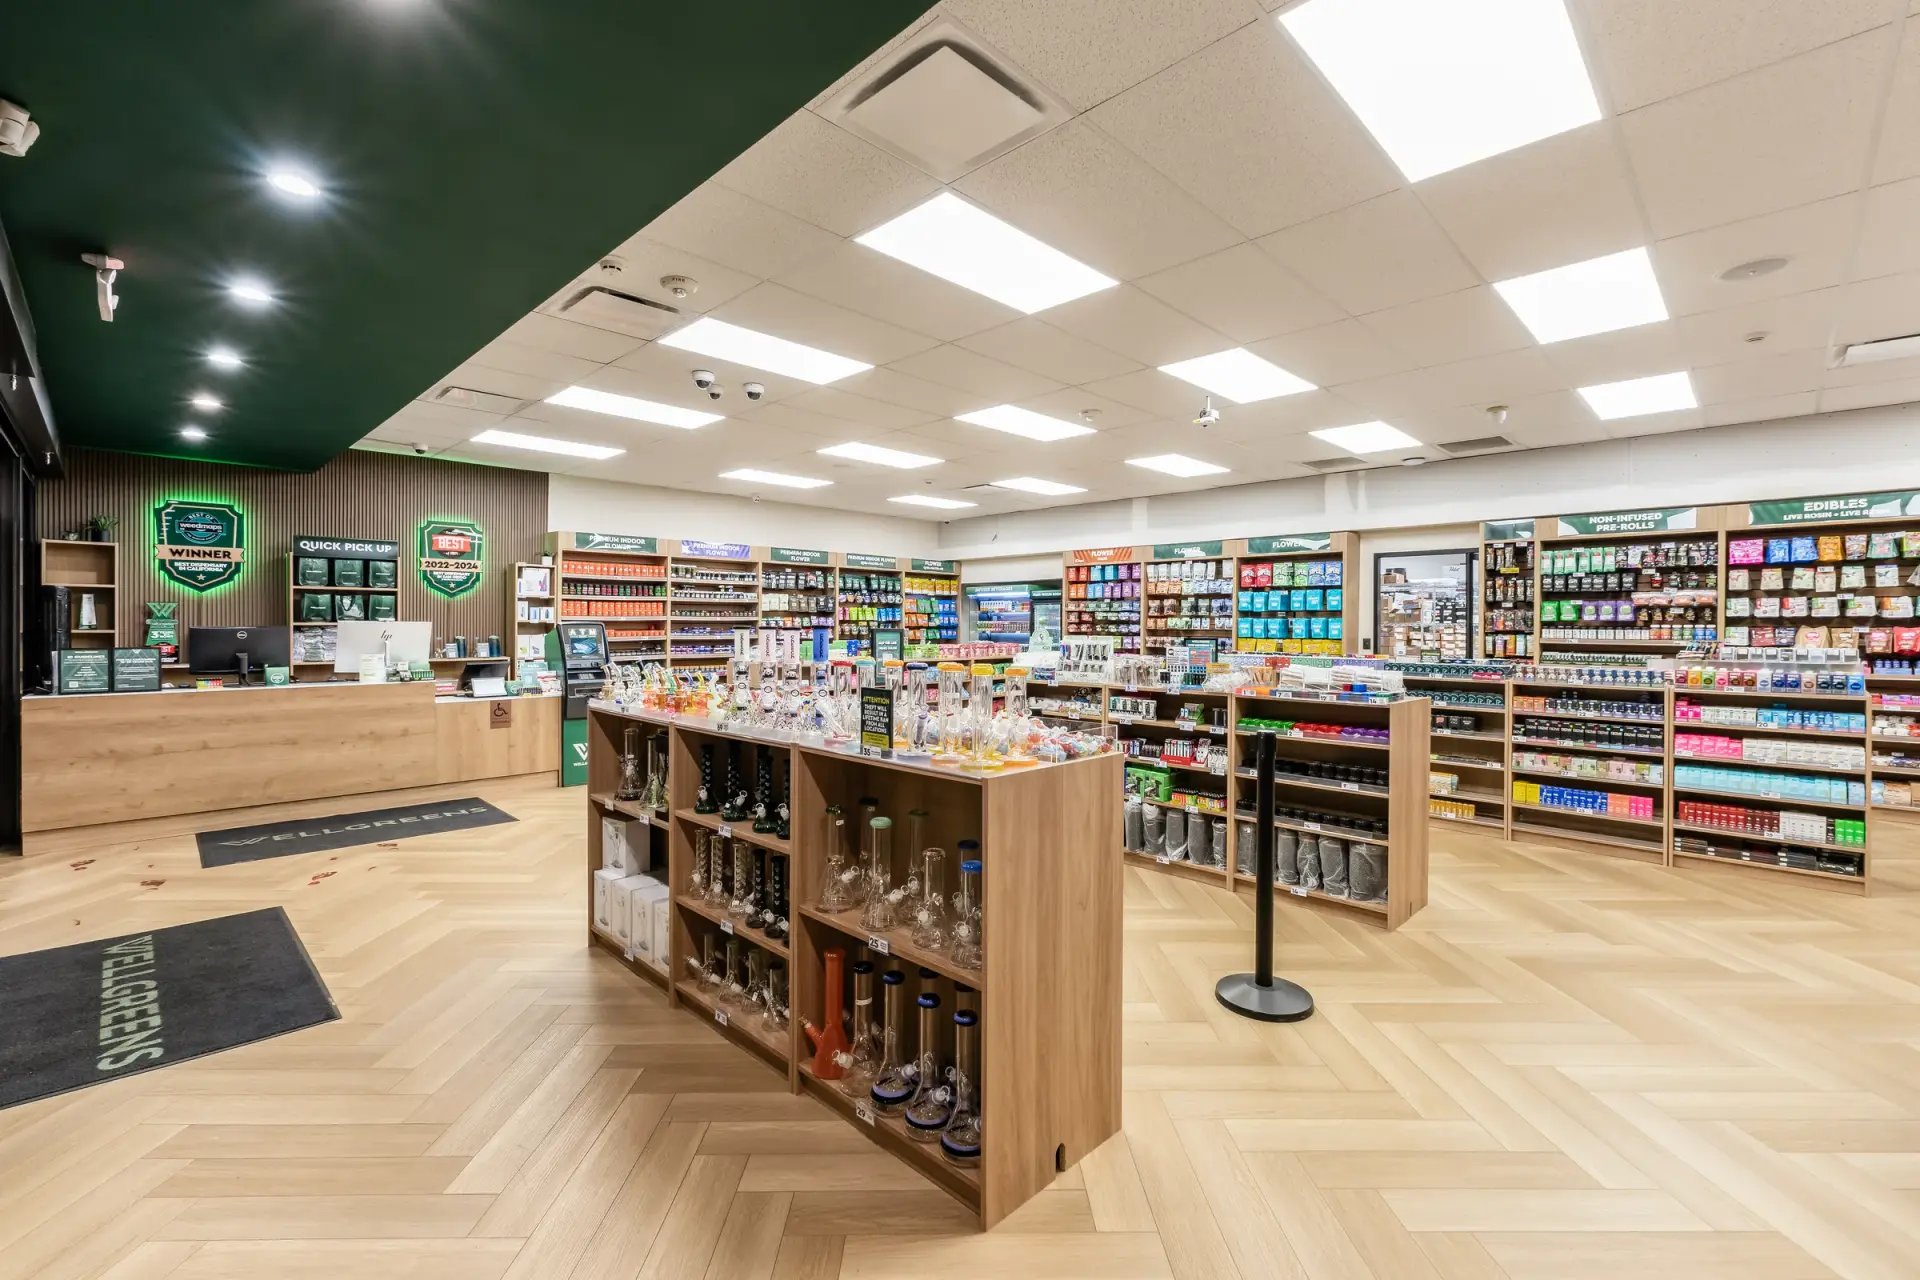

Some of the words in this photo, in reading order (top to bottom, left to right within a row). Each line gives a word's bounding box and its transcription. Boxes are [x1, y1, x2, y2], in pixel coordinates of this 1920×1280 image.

[1803, 498, 1868, 512] EDIBLES
[1589, 512, 1663, 524] NON-INFUSED
[1783, 513, 1803, 521] LIVE
[1804, 511, 1832, 520] ROSIN
[1840, 509, 1861, 518] LIVE
[179, 522, 223, 531] weedmaps
[1595, 521, 1655, 532] PRE-ROLLS
[299, 540, 341, 552] QUICK
[344, 542, 373, 552] PICK
[376, 544, 392, 553] UP
[438, 537, 465, 549] BEST
[620, 537, 646, 545] INDOOR
[169, 548, 232, 560] WINNER
[780, 549, 802, 557] PREMIUM
[1174, 546, 1201, 554] FLOWER
[425, 560, 479, 570] 2022-2024
[151, 630, 159, 639] 3
[568, 628, 597, 636] ATM
[862, 696, 890, 705] ATTENTION
[864, 726, 887, 734] LOCATIONS
[863, 747, 871, 756] 35
[218, 805, 488, 848] WELLGREENS
[870, 937, 879, 949] 25
[96, 934, 165, 1071] WELLGREENS
[857, 1106, 865, 1118] 29
